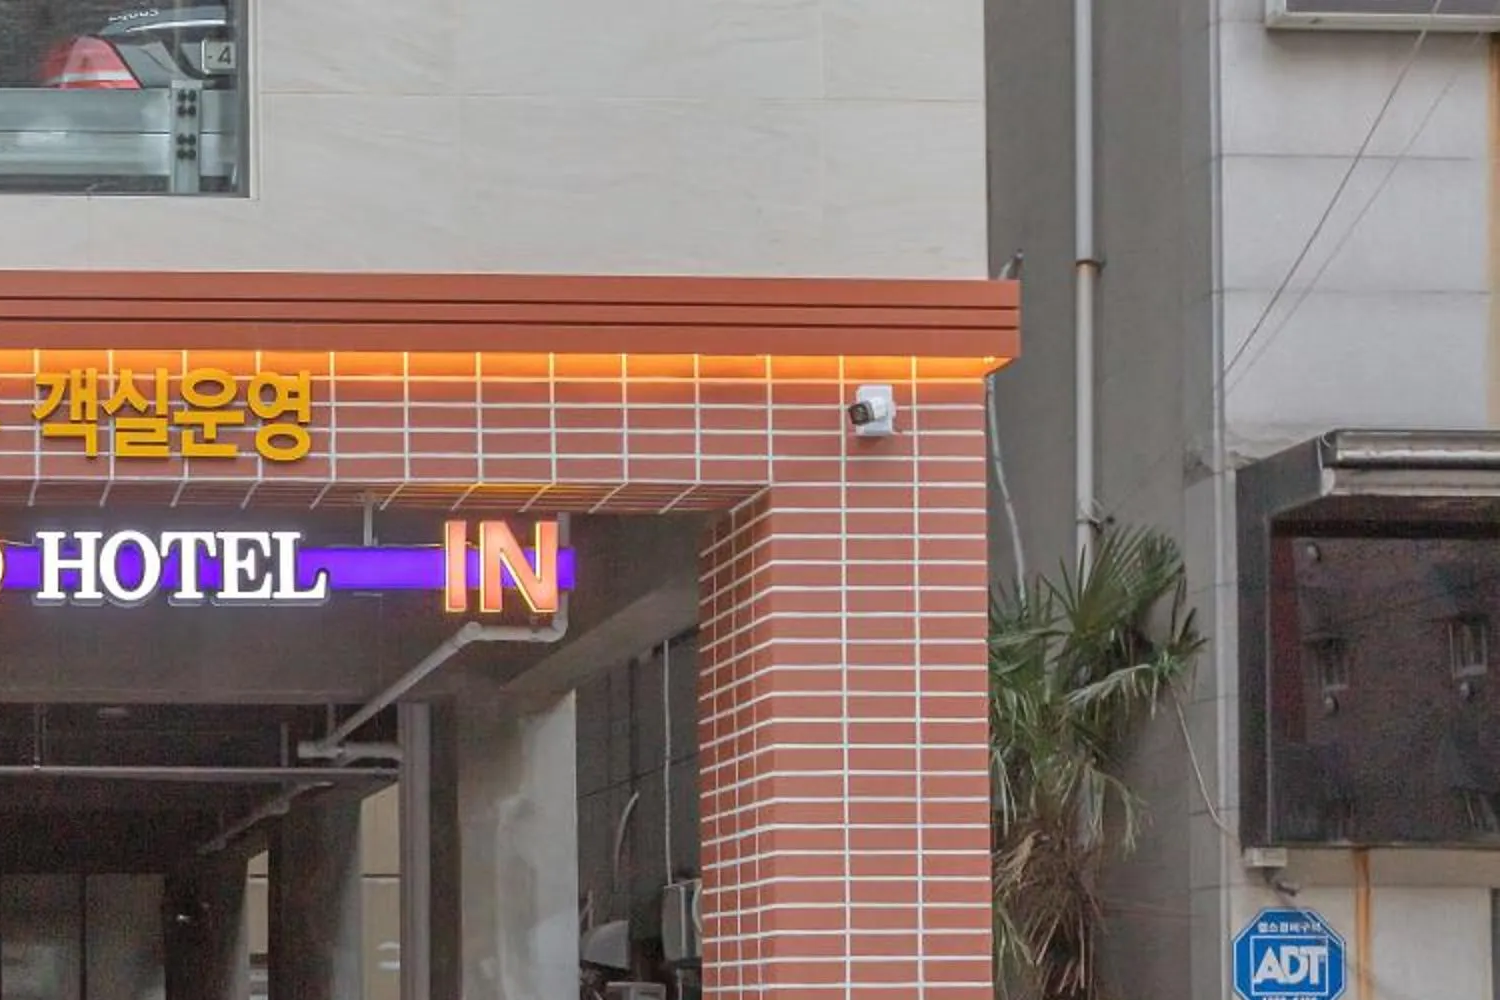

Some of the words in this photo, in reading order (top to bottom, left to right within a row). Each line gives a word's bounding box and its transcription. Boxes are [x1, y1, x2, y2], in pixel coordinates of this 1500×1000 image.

[32, 367, 312, 461] 객실운영
[35, 530, 330, 603] HOTEL
[444, 520, 560, 613] IN
[1252, 945, 1328, 985] ADT
